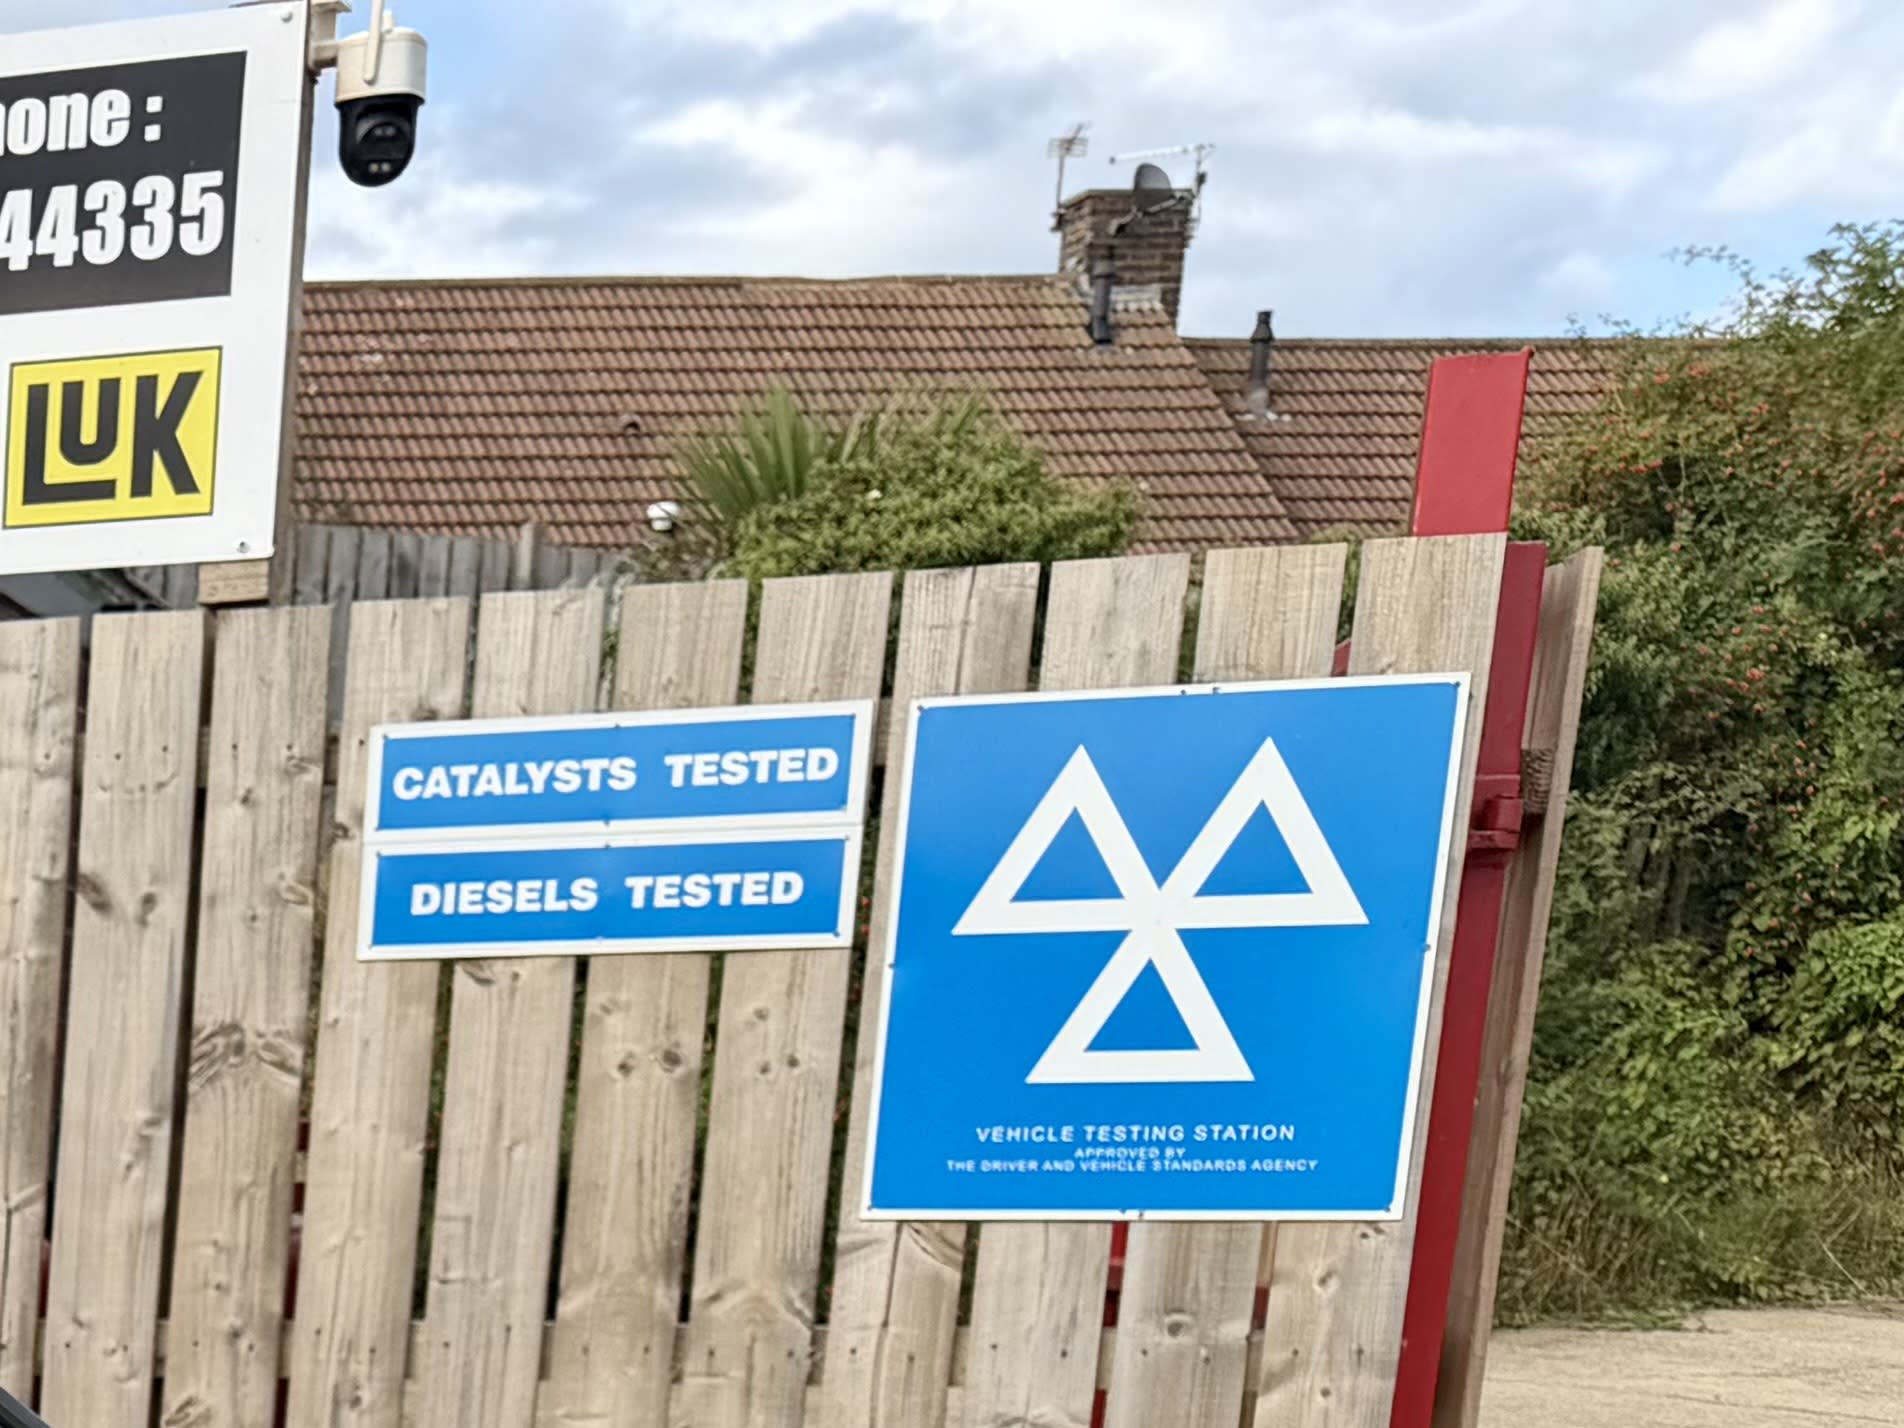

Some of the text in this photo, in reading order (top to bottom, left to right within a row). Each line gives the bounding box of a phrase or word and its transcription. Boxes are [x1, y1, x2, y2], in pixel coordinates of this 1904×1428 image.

[394, 749, 838, 799] CATALYSTS TESTED
[412, 873, 802, 914] DIESELS TESTED
[976, 1124, 1295, 1143] VEHICLE TESTING STATION
[1074, 1147, 1186, 1159] APPROVED BY
[947, 1159, 1319, 1172] THE DRIVER AND VEHICLE STANDARDS AGENCY
